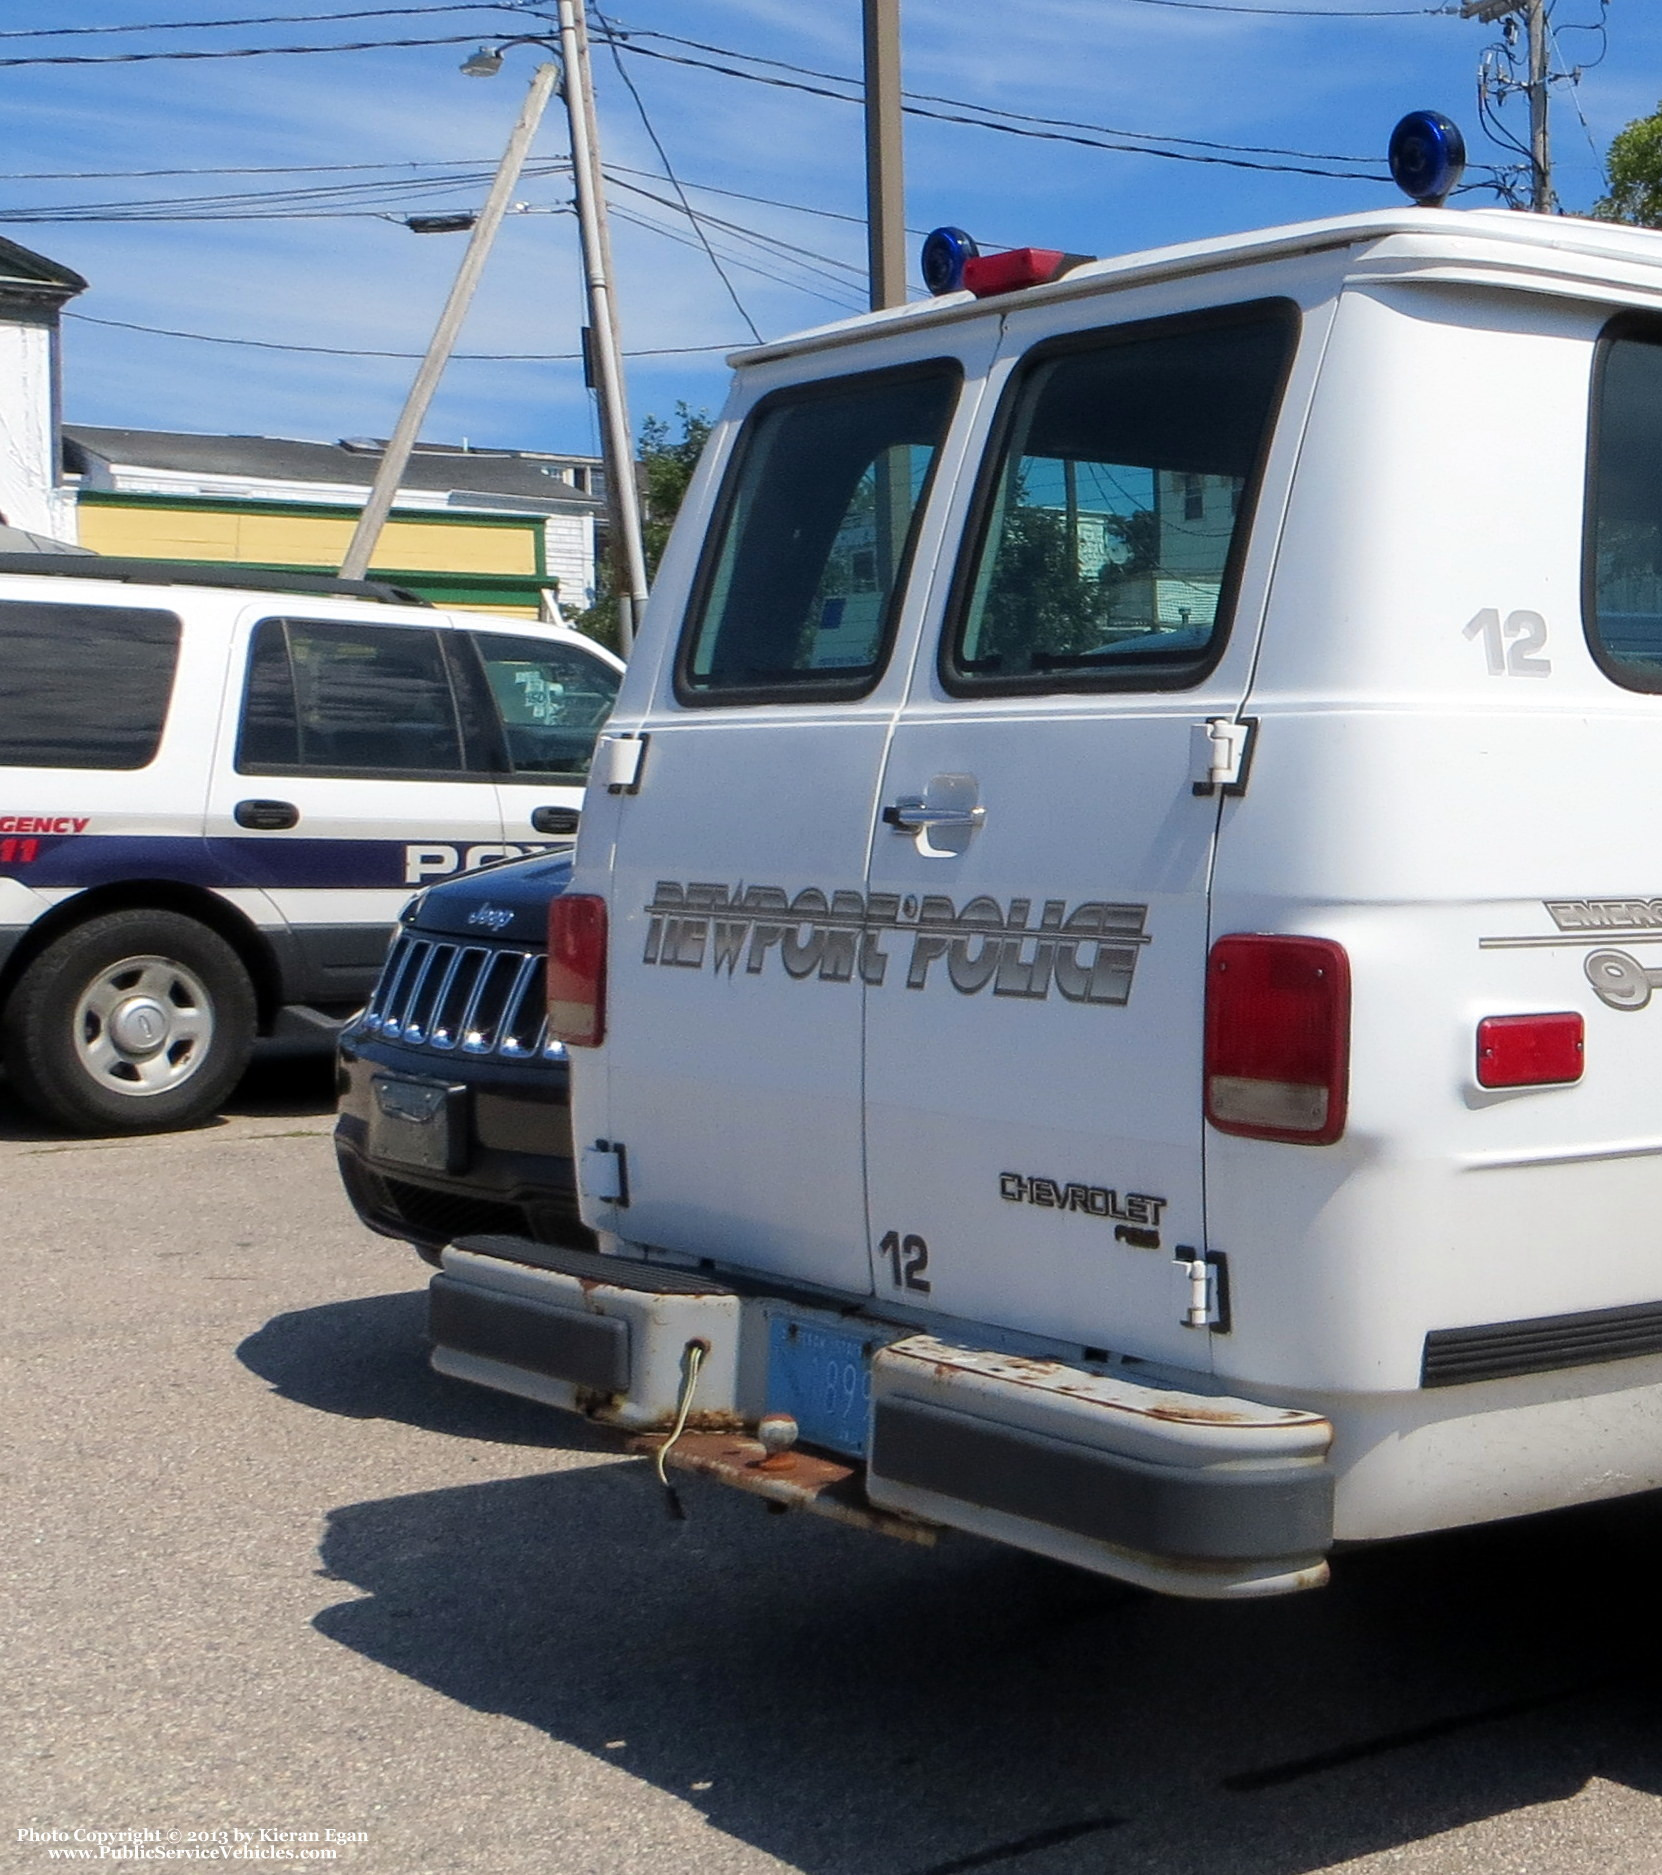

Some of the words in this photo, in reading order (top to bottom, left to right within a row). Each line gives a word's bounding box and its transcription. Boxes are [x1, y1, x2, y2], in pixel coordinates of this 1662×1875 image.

[1462, 608, 1551, 678] 12
[0, 815, 91, 833] GENCY
[404, 844, 547, 884] PO
[468, 902, 515, 932] Jeep
[643, 879, 900, 986] NEWPORT
[906, 895, 1148, 1006] POLICE
[999, 1171, 1167, 1226] CHEVROLET
[878, 1230, 931, 1293] 12
